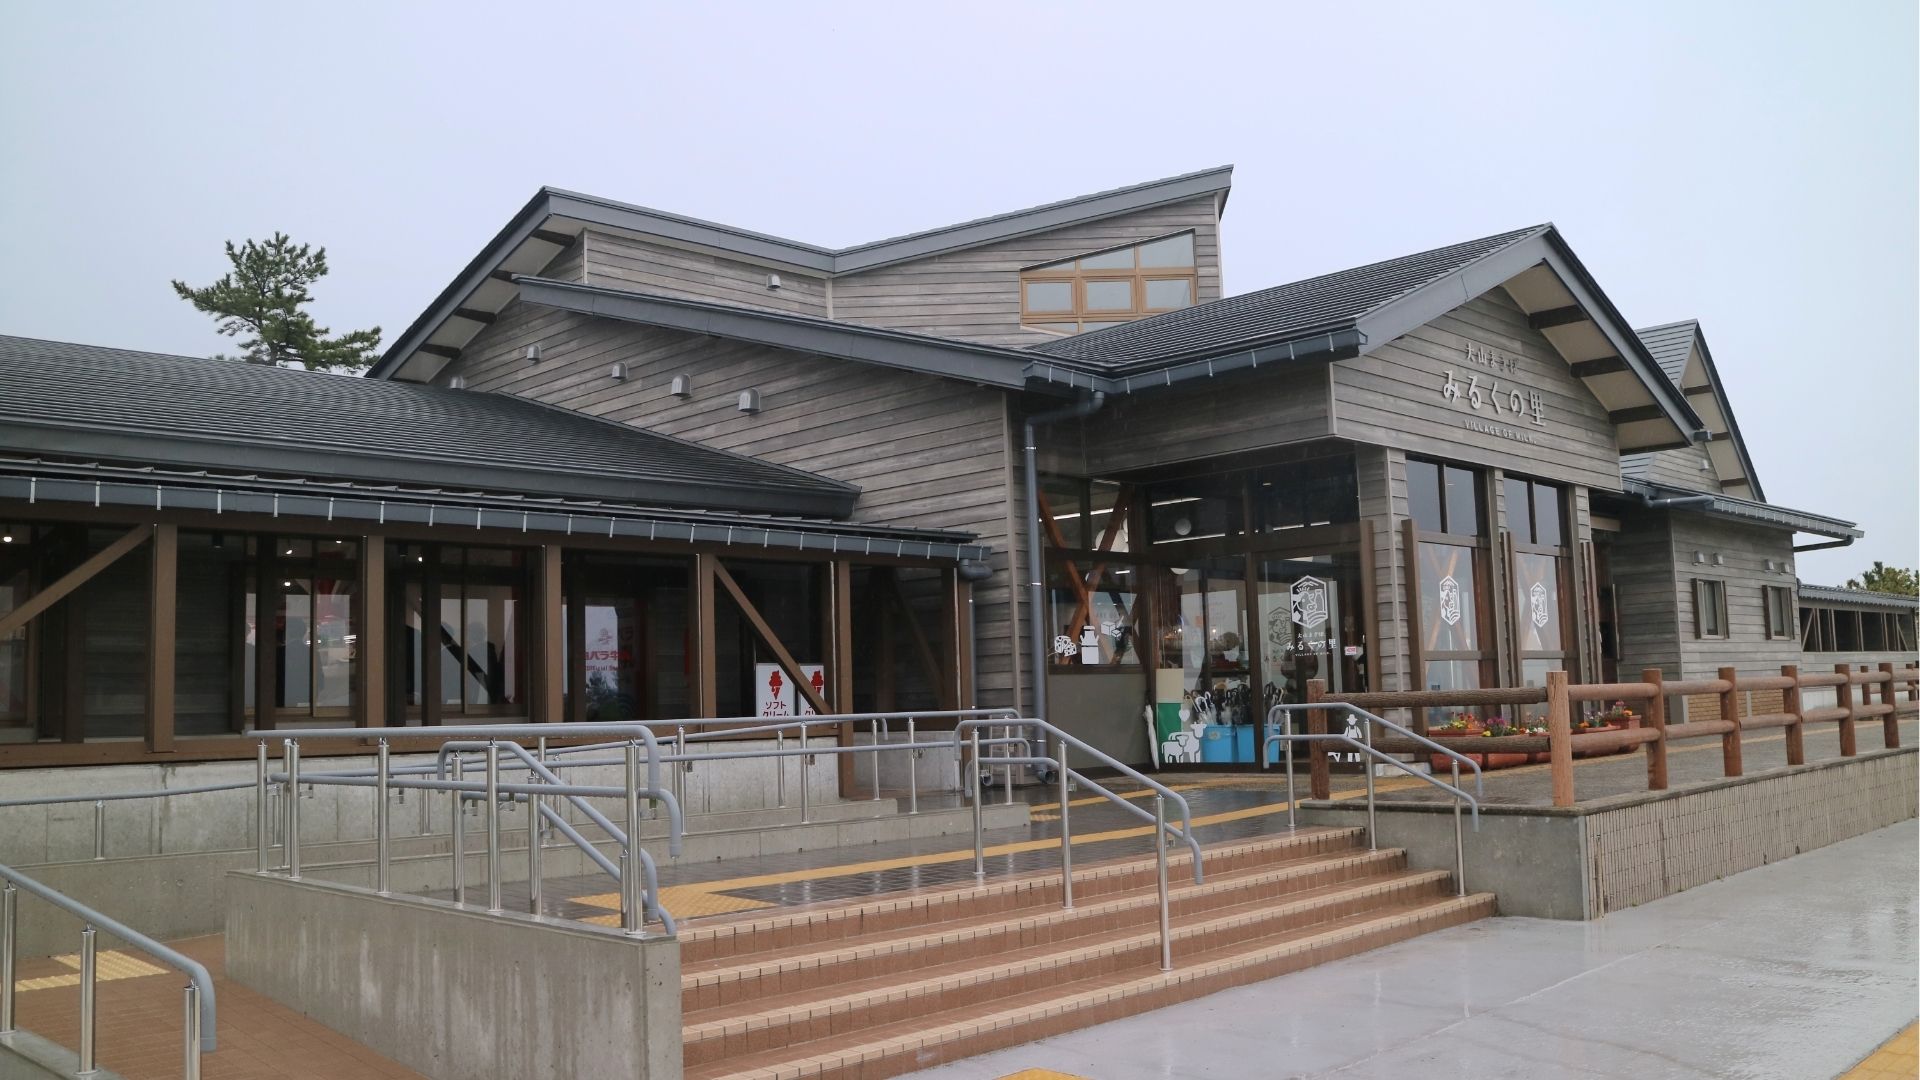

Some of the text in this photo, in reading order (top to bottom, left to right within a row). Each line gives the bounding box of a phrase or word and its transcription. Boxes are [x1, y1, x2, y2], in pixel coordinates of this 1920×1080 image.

[1443, 370, 1546, 426] みるくの里
[1465, 418, 1500, 435] VILLAGE
[1503, 428, 1512, 437] OF
[765, 700, 787, 709] ソフト
